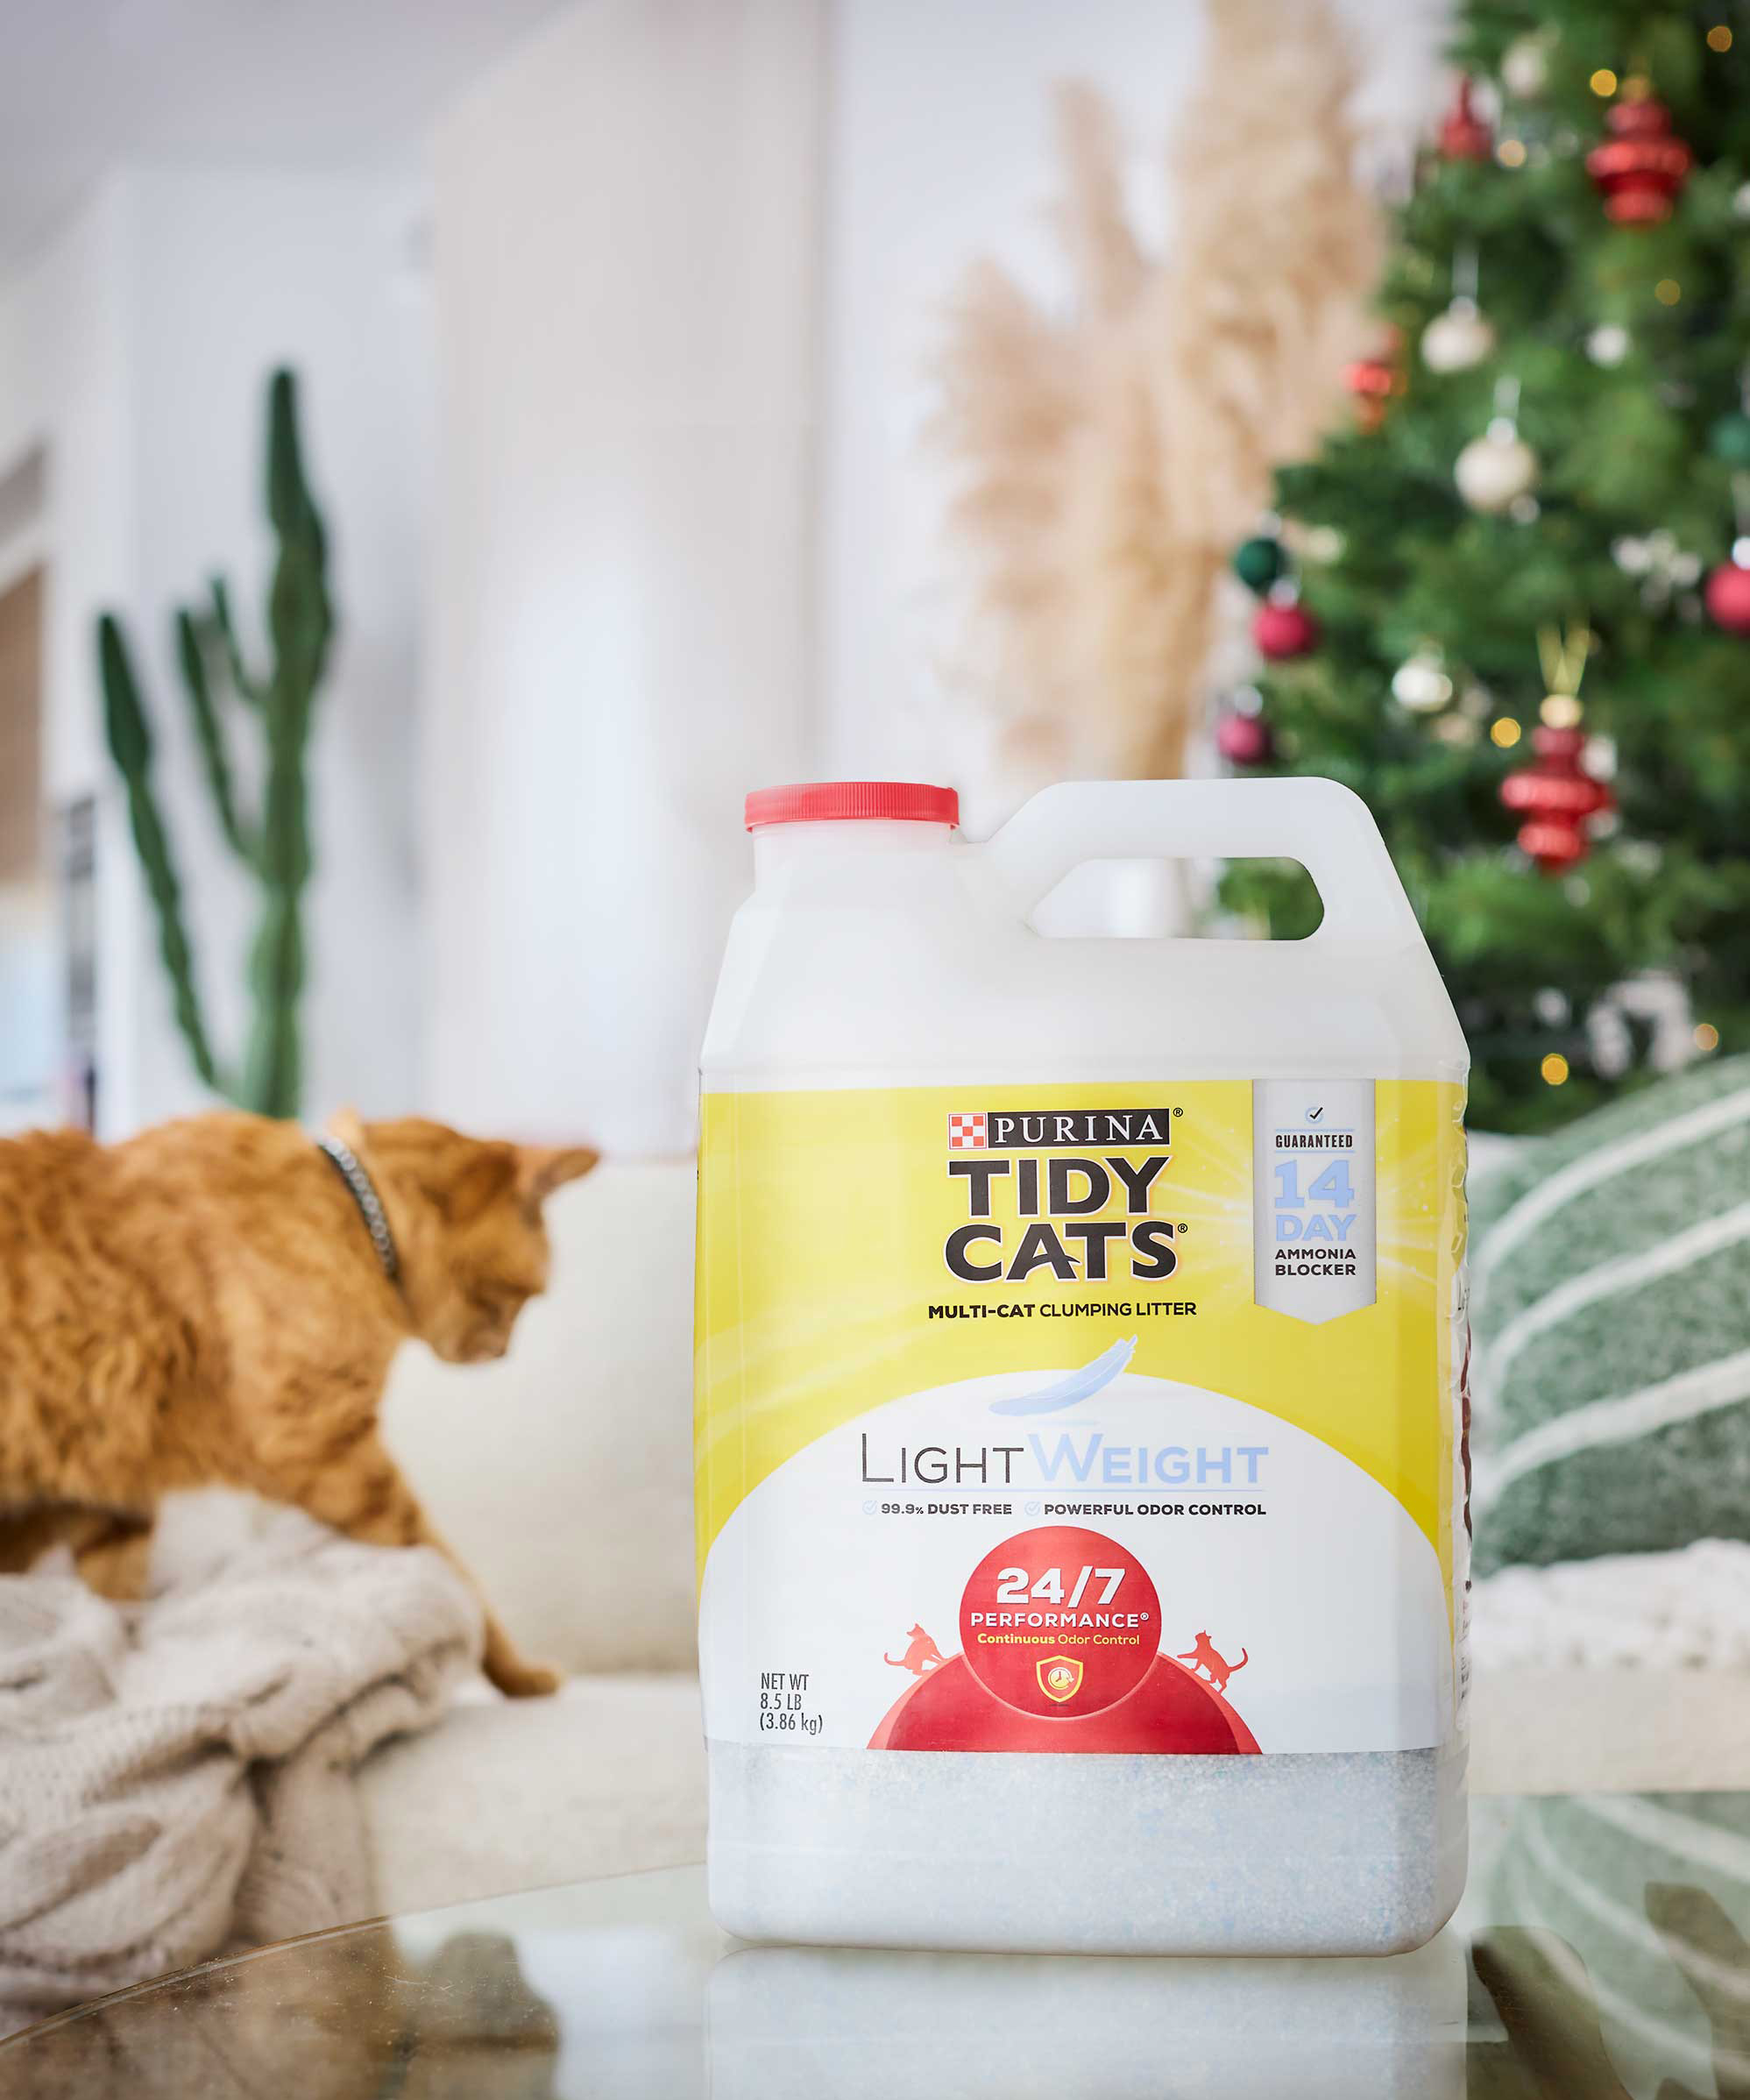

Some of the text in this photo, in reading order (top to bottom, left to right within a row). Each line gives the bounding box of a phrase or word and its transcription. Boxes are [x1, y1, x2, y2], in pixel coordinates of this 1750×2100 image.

[1275, 1134, 1354, 1148] GUARANTEED
[947, 1155, 1171, 1217] TIDY
[1274, 1159, 1355, 1209] 14
[1275, 1214, 1357, 1242] DAY
[1274, 1248, 1357, 1260] AMMONIA
[1275, 1263, 1357, 1276] BLOCKER
[928, 1302, 1197, 1319] MULTI-CAT CLUMPING LITTER
[881, 1502, 1013, 1515] 99.9% DUST FREE
[1044, 1503, 1267, 1516] POWERFUL ODOR CONTROL
[995, 1564, 1127, 1608] 24/7
[976, 1633, 1140, 1646] Continuous Odor Control
[761, 1672, 810, 1692] NET WT
[760, 1692, 802, 1711] 8.5 LB
[759, 1712, 824, 1736] (3.86 kg)
